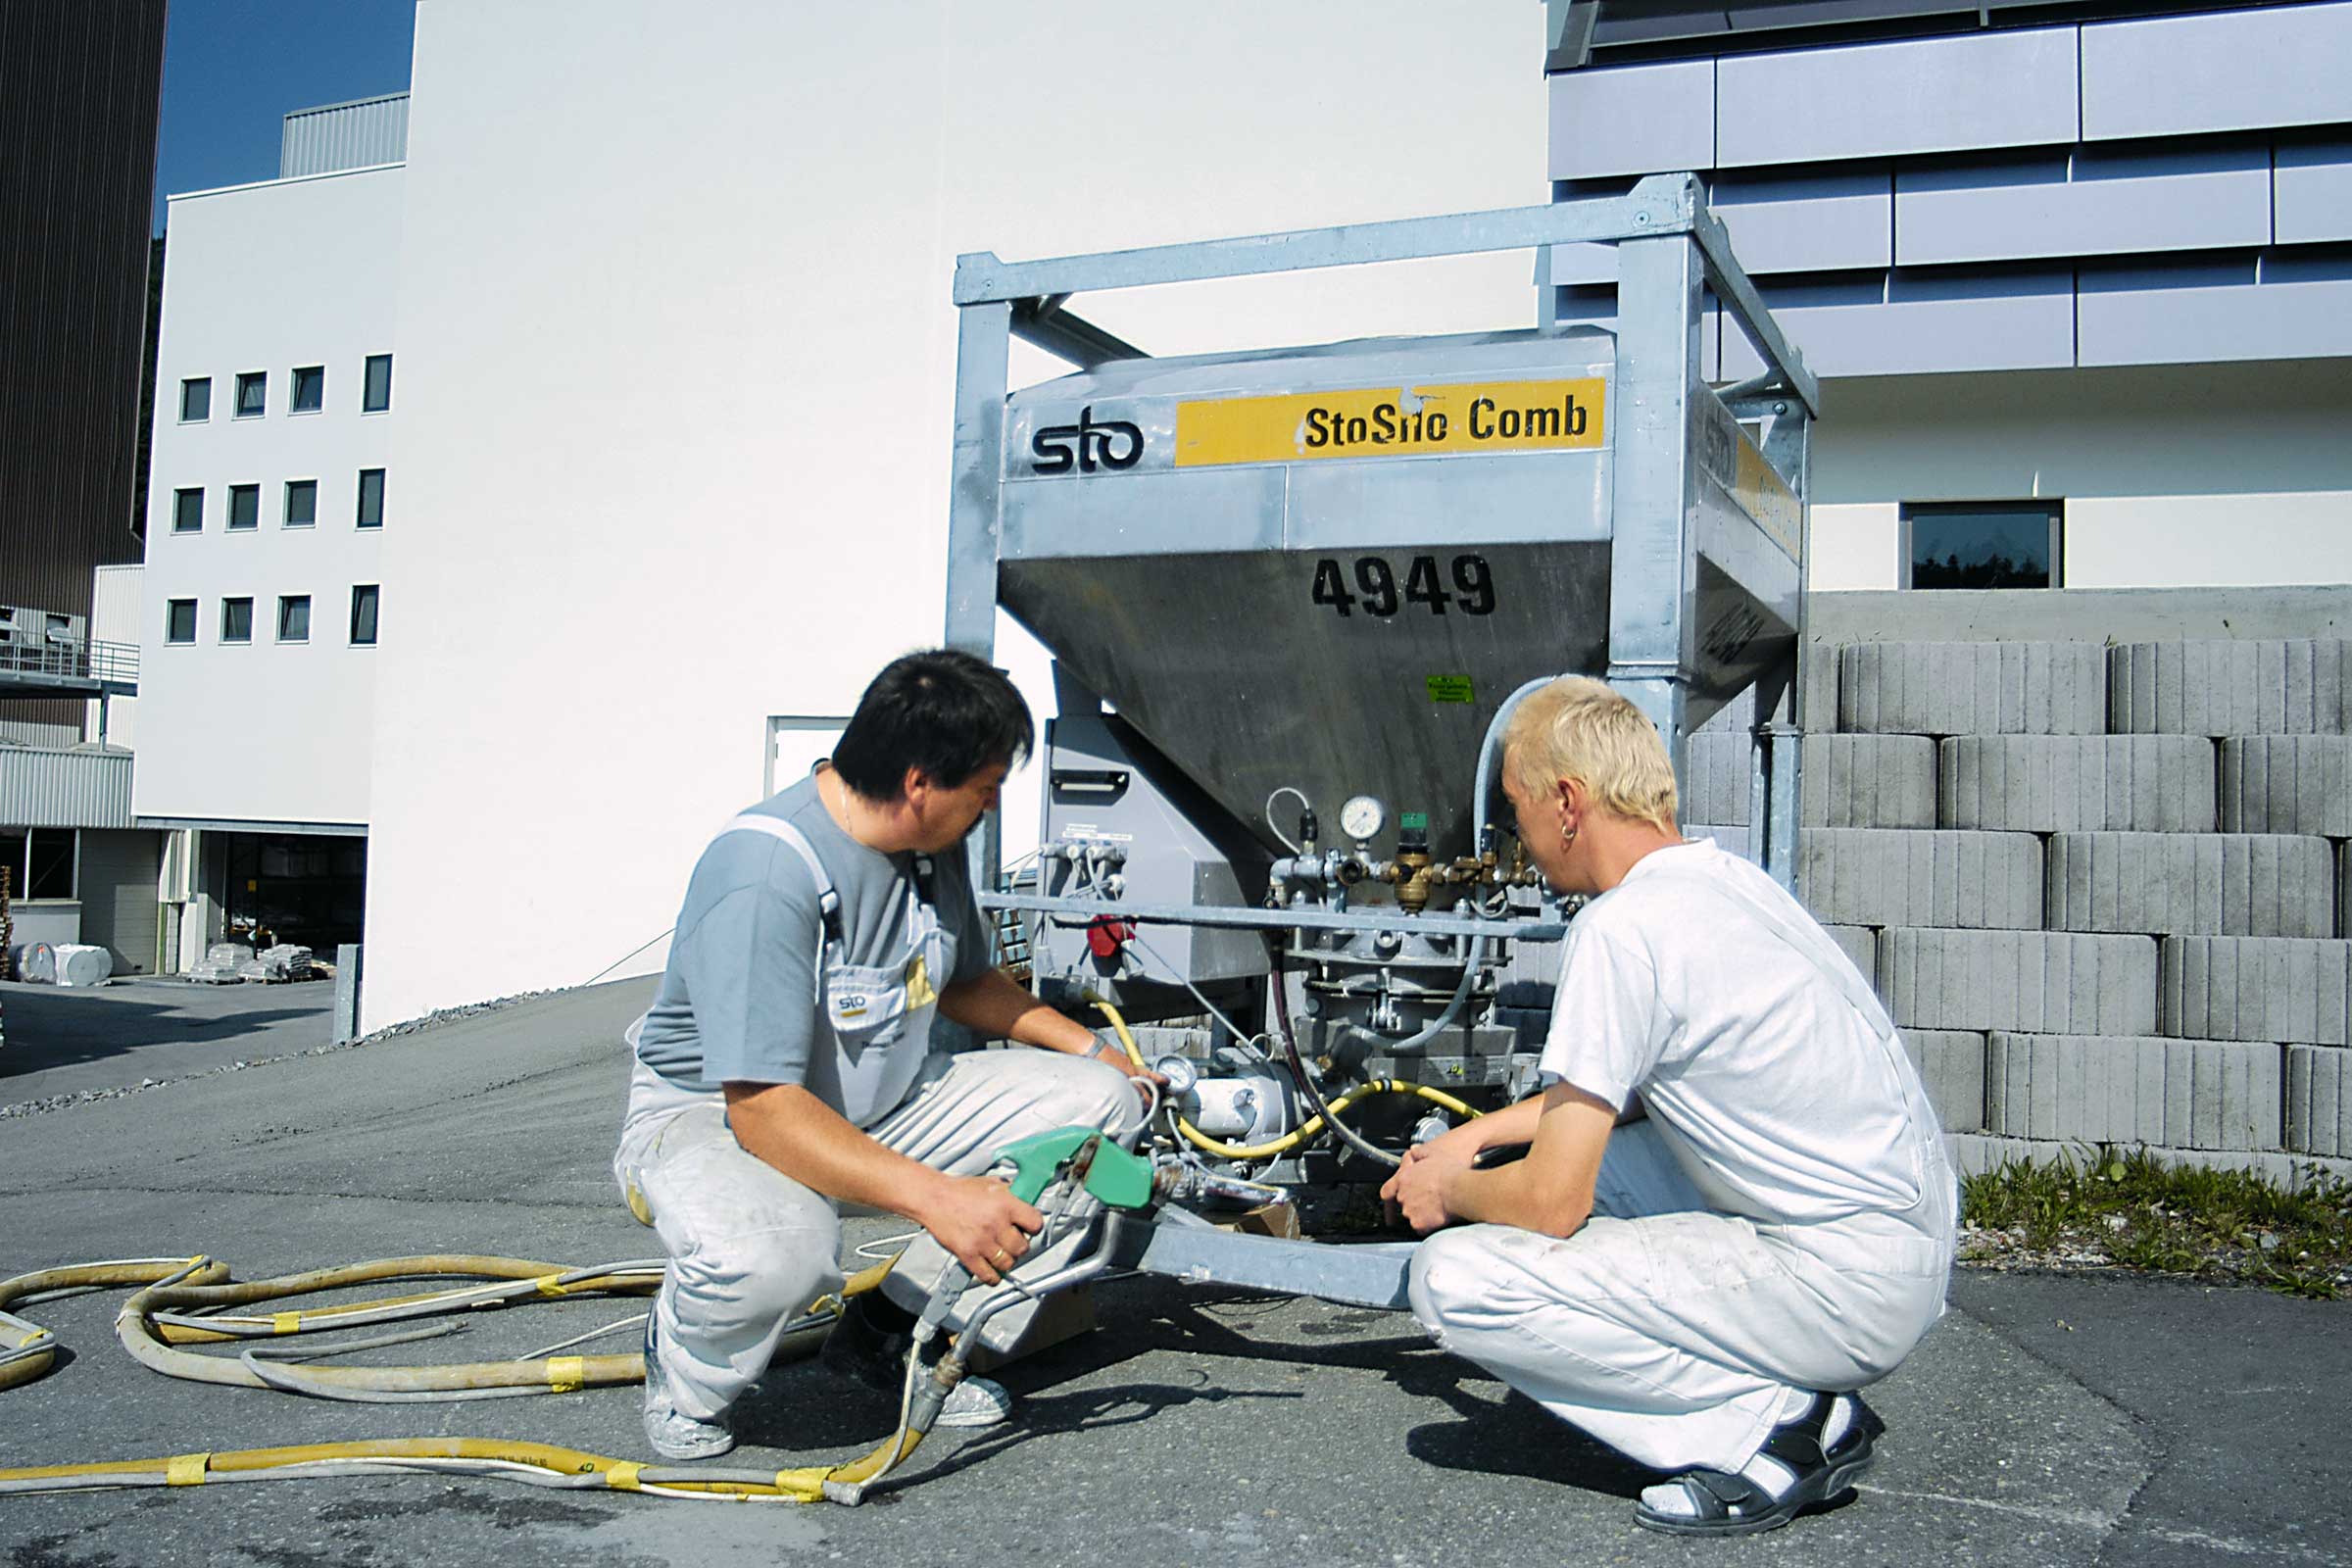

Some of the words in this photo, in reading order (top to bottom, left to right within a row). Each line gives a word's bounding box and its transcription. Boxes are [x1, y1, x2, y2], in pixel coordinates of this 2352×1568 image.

[1031, 405, 1145, 475] sto
[1470, 394, 1588, 439] Comb
[1311, 555, 1496, 617] 4949
